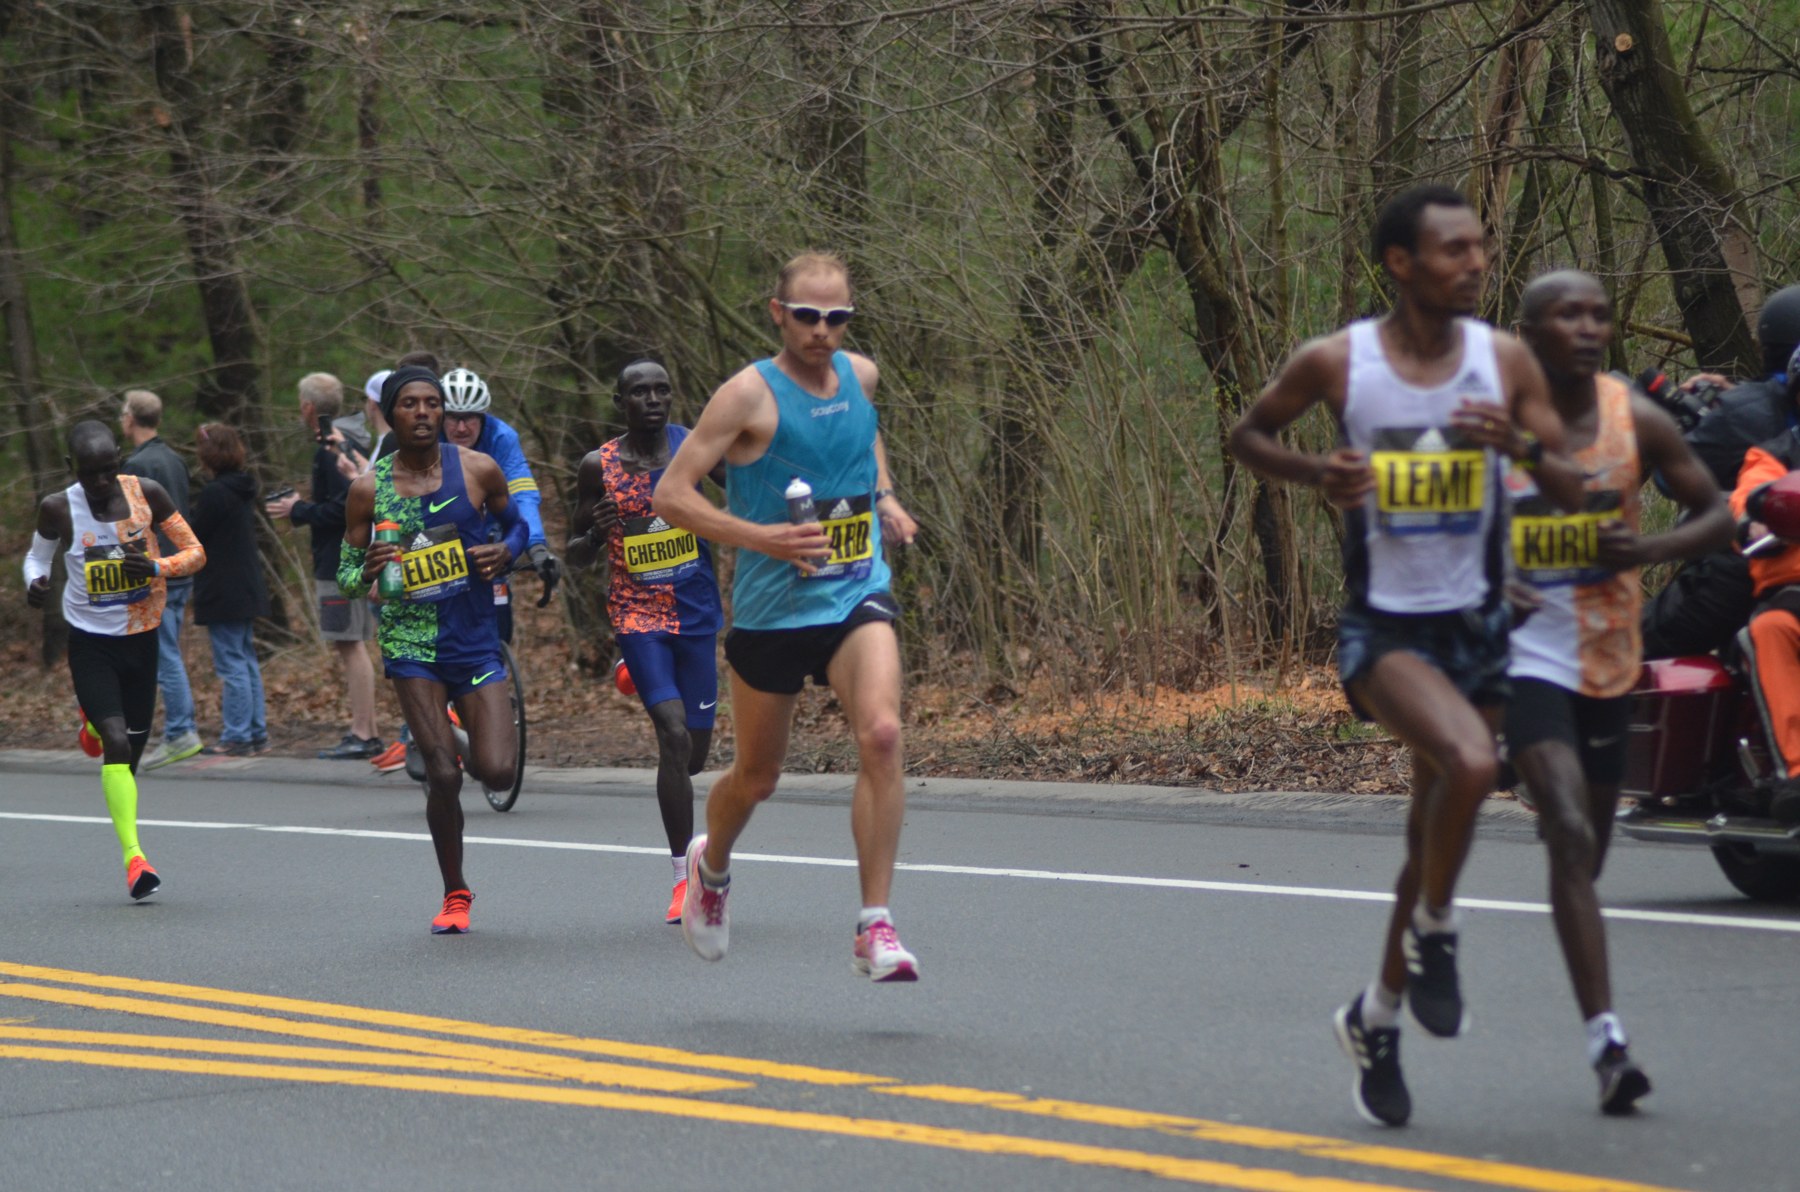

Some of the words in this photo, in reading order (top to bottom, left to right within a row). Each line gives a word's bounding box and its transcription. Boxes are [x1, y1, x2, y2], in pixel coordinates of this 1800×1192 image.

[1388, 461, 1471, 507] LEMI
[628, 533, 694, 565] CHERONO
[823, 518, 870, 558] ARD
[90, 563, 146, 592] RON
[403, 547, 464, 588] ELISA
